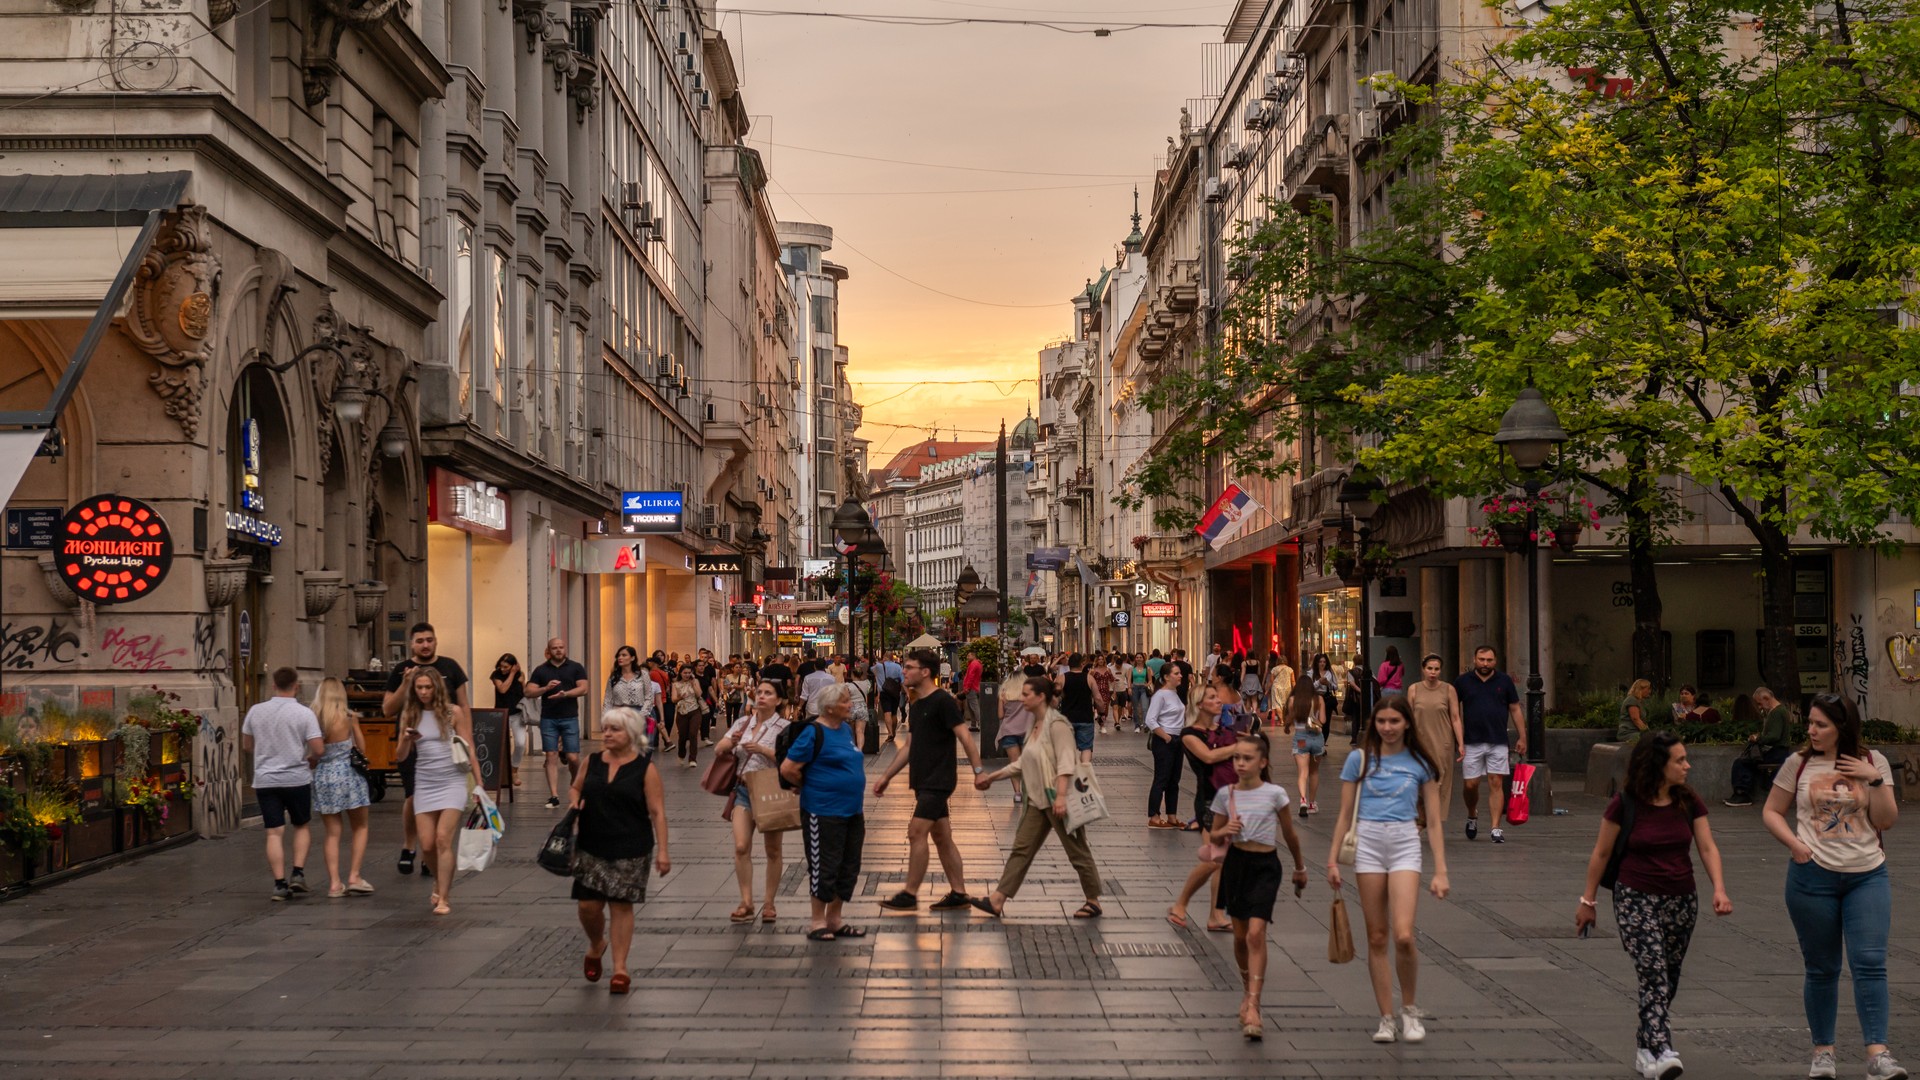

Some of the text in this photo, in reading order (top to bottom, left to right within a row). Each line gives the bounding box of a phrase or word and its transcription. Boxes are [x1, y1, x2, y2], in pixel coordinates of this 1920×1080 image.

[643, 499, 681, 507] ILIRIKA
[64, 540, 164, 556] MONUMENT
[83, 555, 144, 566] Руски Цар
[614, 543, 641, 570] A1
[698, 563, 740, 572] ZARA
[1799, 626, 1822, 635] SBG
